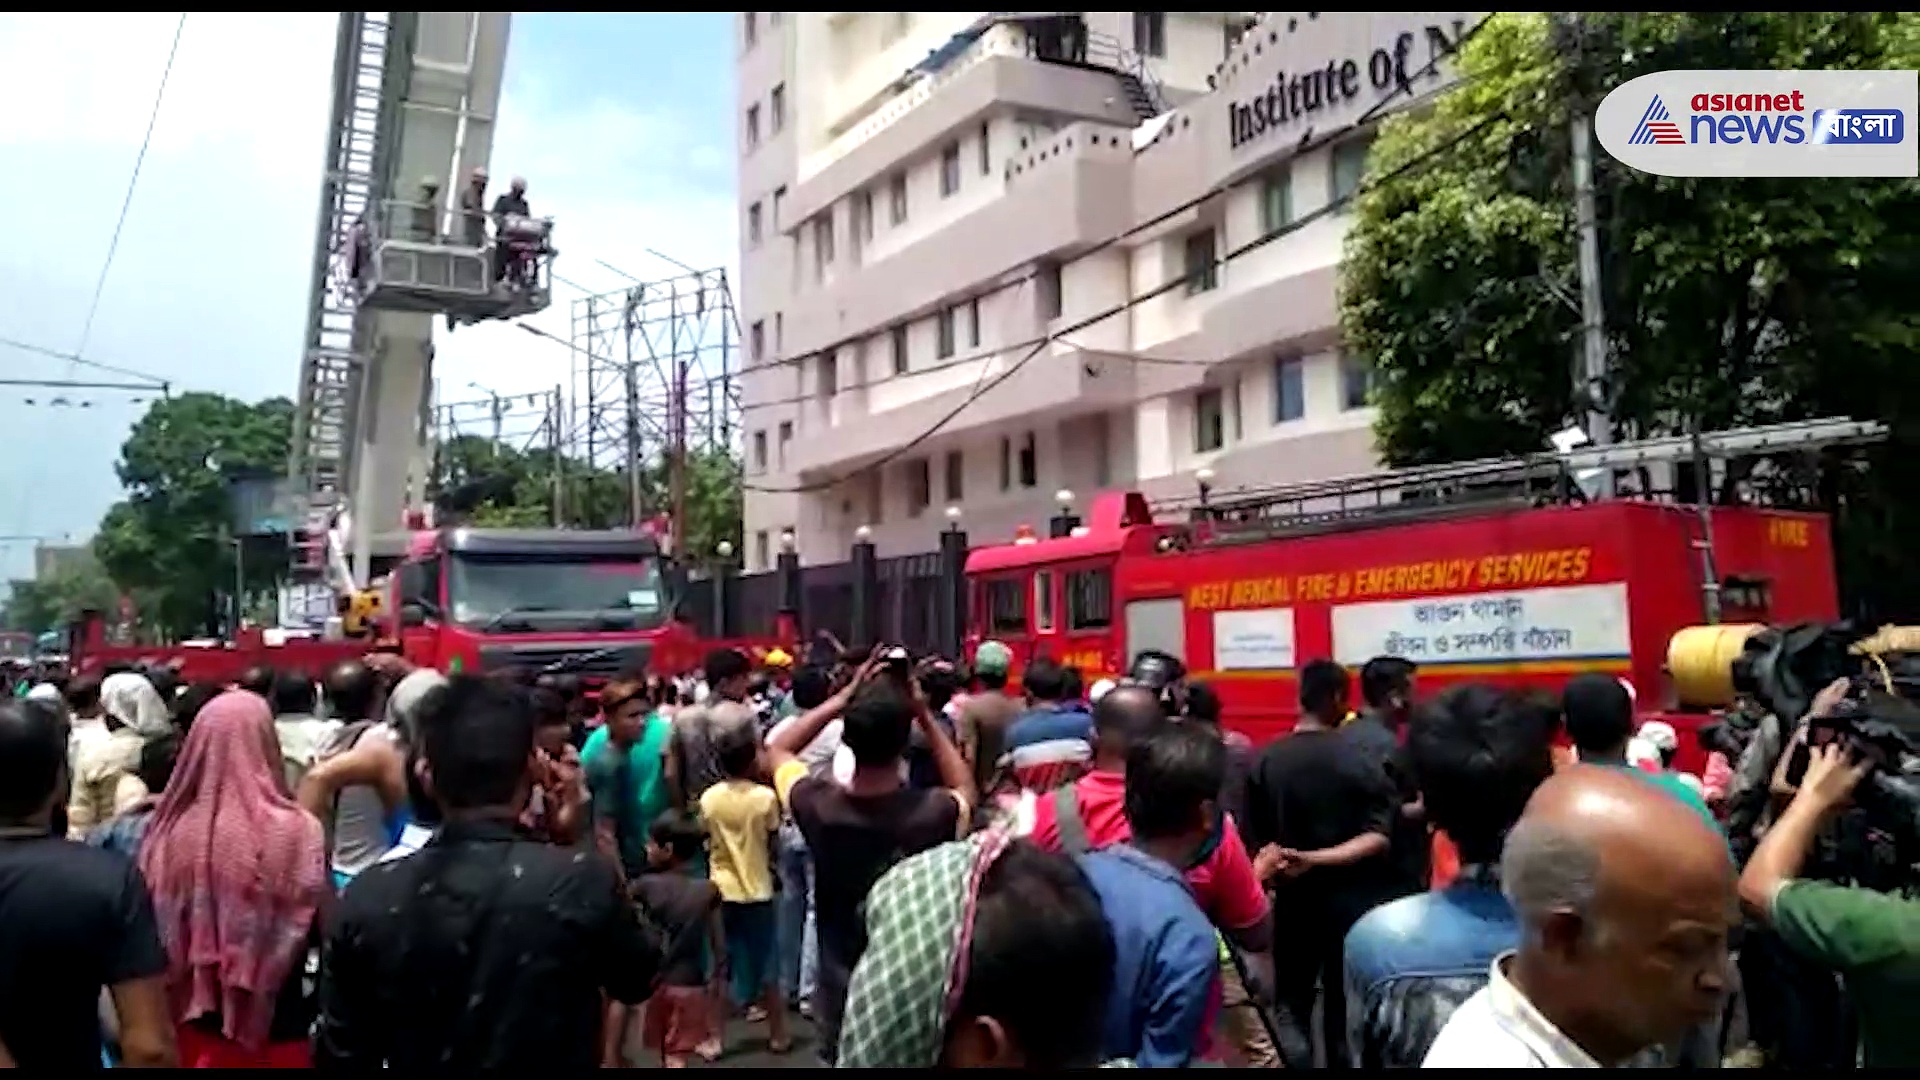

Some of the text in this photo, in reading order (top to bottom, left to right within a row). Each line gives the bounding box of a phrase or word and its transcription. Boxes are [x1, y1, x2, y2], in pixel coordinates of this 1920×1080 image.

[1228, 57, 1359, 150] Institute
[1368, 31, 1414, 90] of
[1769, 519, 1809, 546] FIRE
[1297, 572, 1337, 601] FIRE
[1354, 557, 1475, 595] EMERGENCY
[1476, 545, 1592, 588] SERVICES
[1434, 633, 1449, 653] ও
